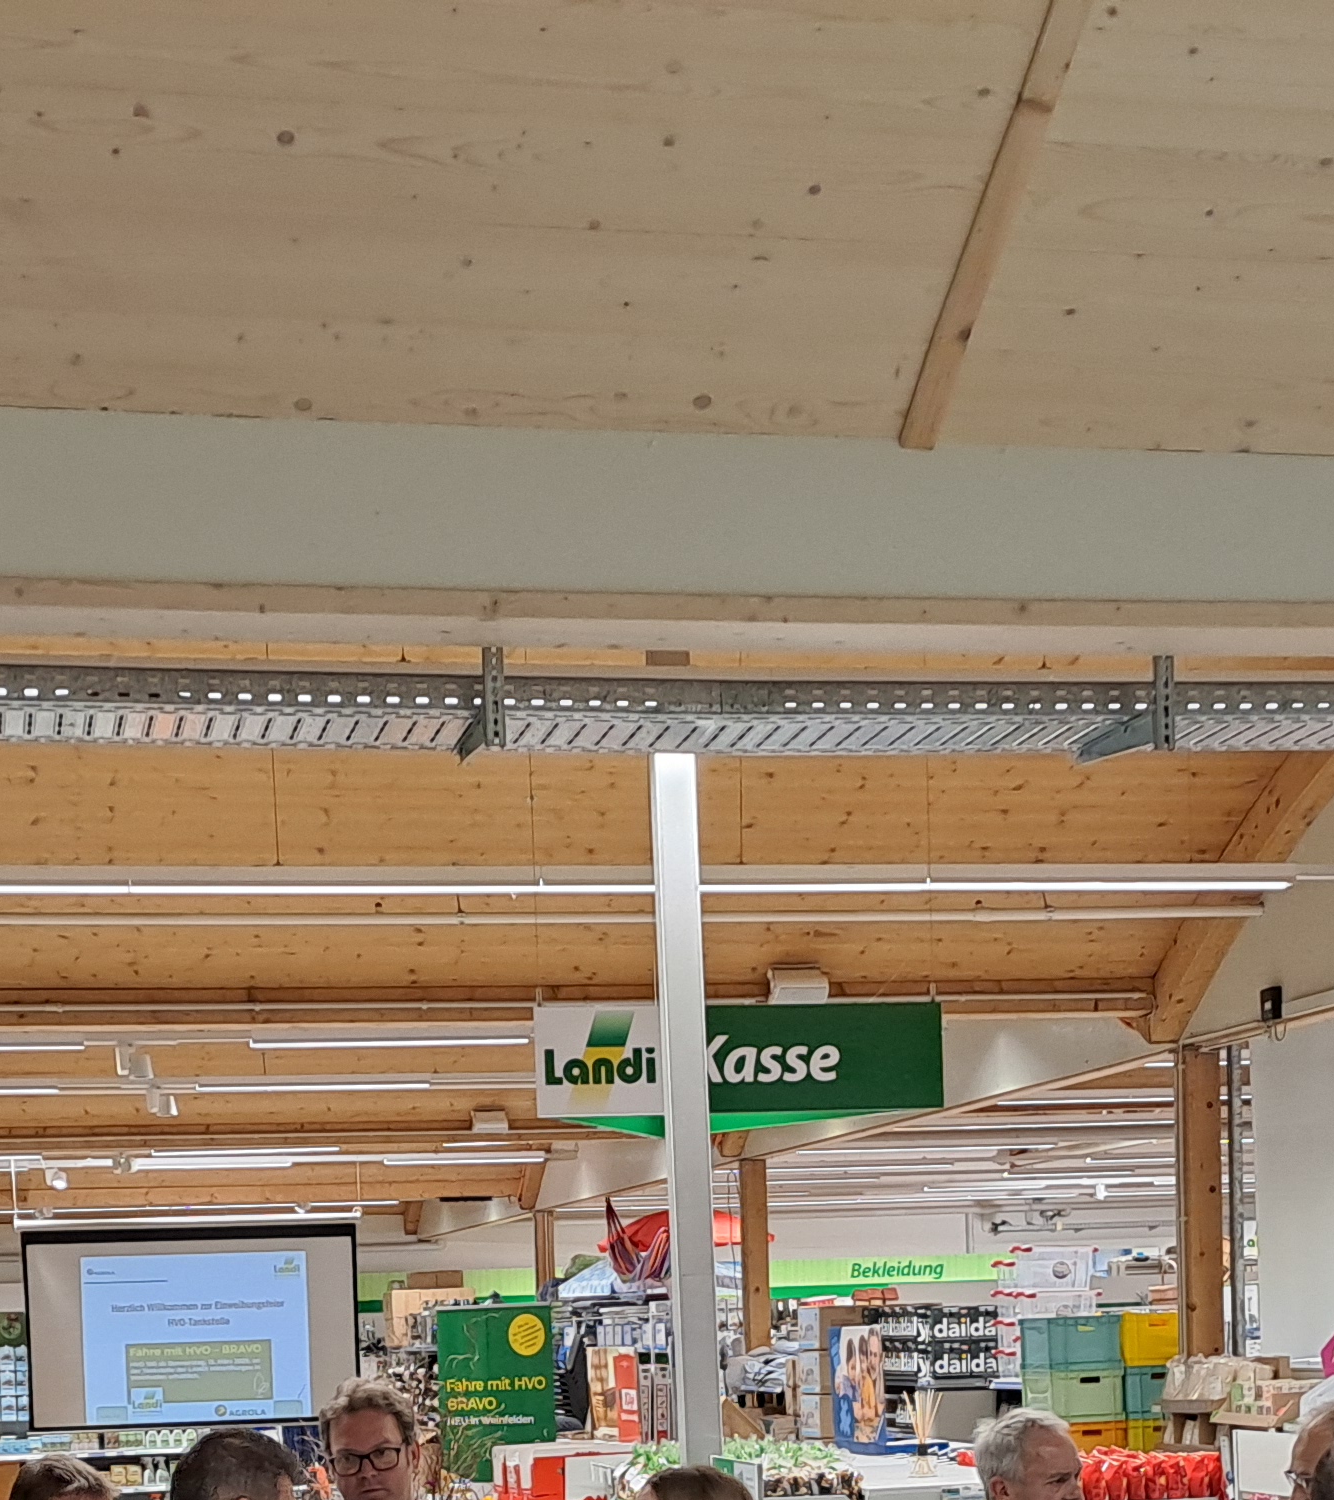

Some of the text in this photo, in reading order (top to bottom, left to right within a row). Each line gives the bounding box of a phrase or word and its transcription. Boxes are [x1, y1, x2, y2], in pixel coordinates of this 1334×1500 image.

[544, 1046, 657, 1086] Landi
[850, 1260, 945, 1280] Bekleidung
[129, 1347, 162, 1357] Fahre
[185, 1345, 211, 1355] HVO
[222, 1344, 263, 1355] BRAVO
[446, 1376, 546, 1392] Fahre mit HVO
[447, 1397, 497, 1411] BRAVO
[481, 1414, 535, 1425] Weinfelden
